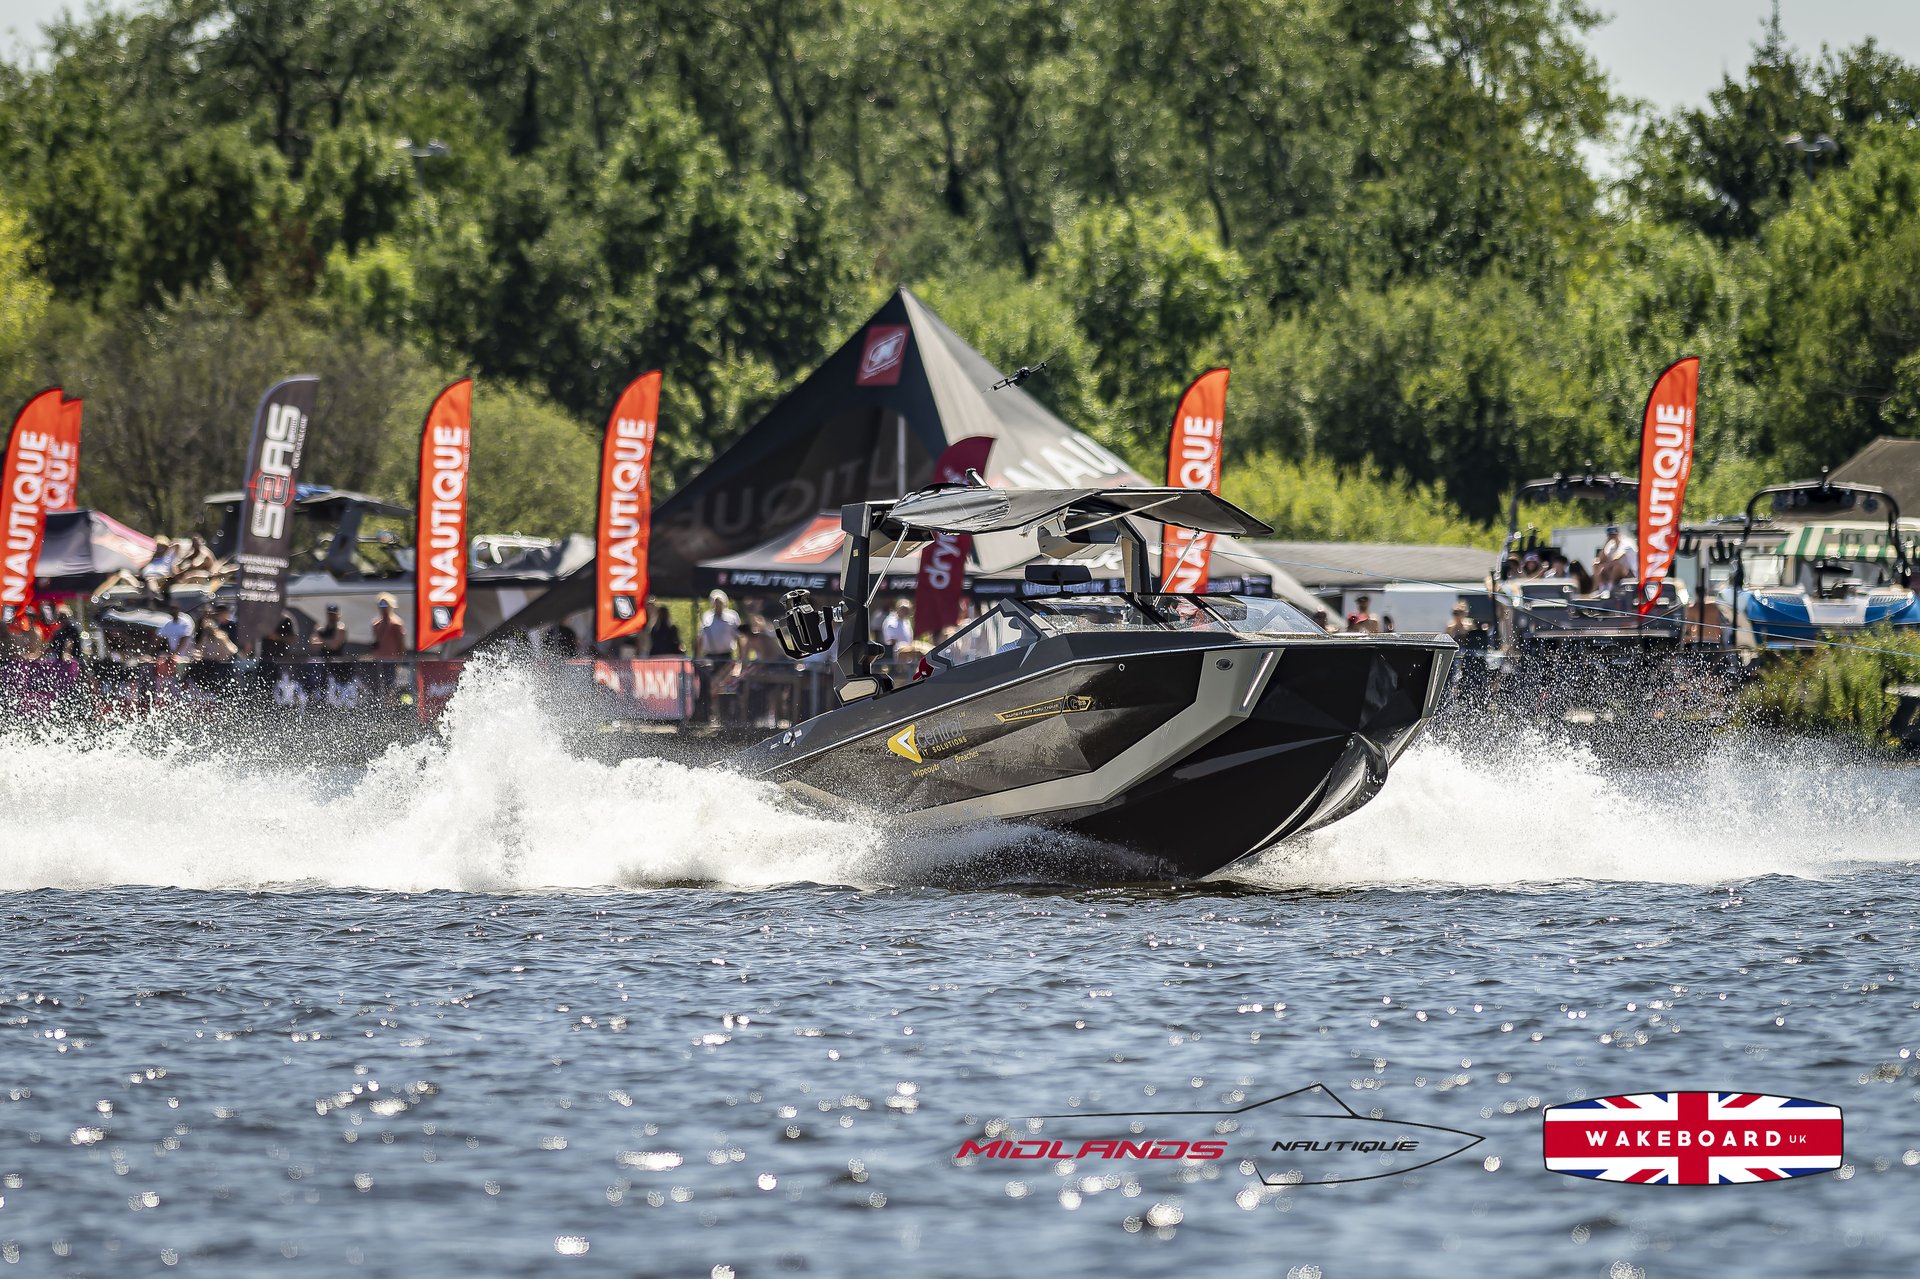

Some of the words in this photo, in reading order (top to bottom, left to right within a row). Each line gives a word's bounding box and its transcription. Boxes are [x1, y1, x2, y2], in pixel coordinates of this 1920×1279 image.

[1, 430, 48, 602] NAUTIQUE
[429, 425, 465, 602] NAUTIQUE
[609, 418, 648, 592] NAUTIQUE
[1172, 415, 1215, 594] NAQUE
[1644, 403, 1686, 579] NAUTIQUE
[731, 572, 827, 588] NAUTIQUE
[911, 763, 940, 778] Wipeouts
[954, 750, 979, 764] Breaches
[915, 714, 965, 748] central
[921, 749, 929, 757] IT
[931, 735, 968, 754] SOLUTIONS
